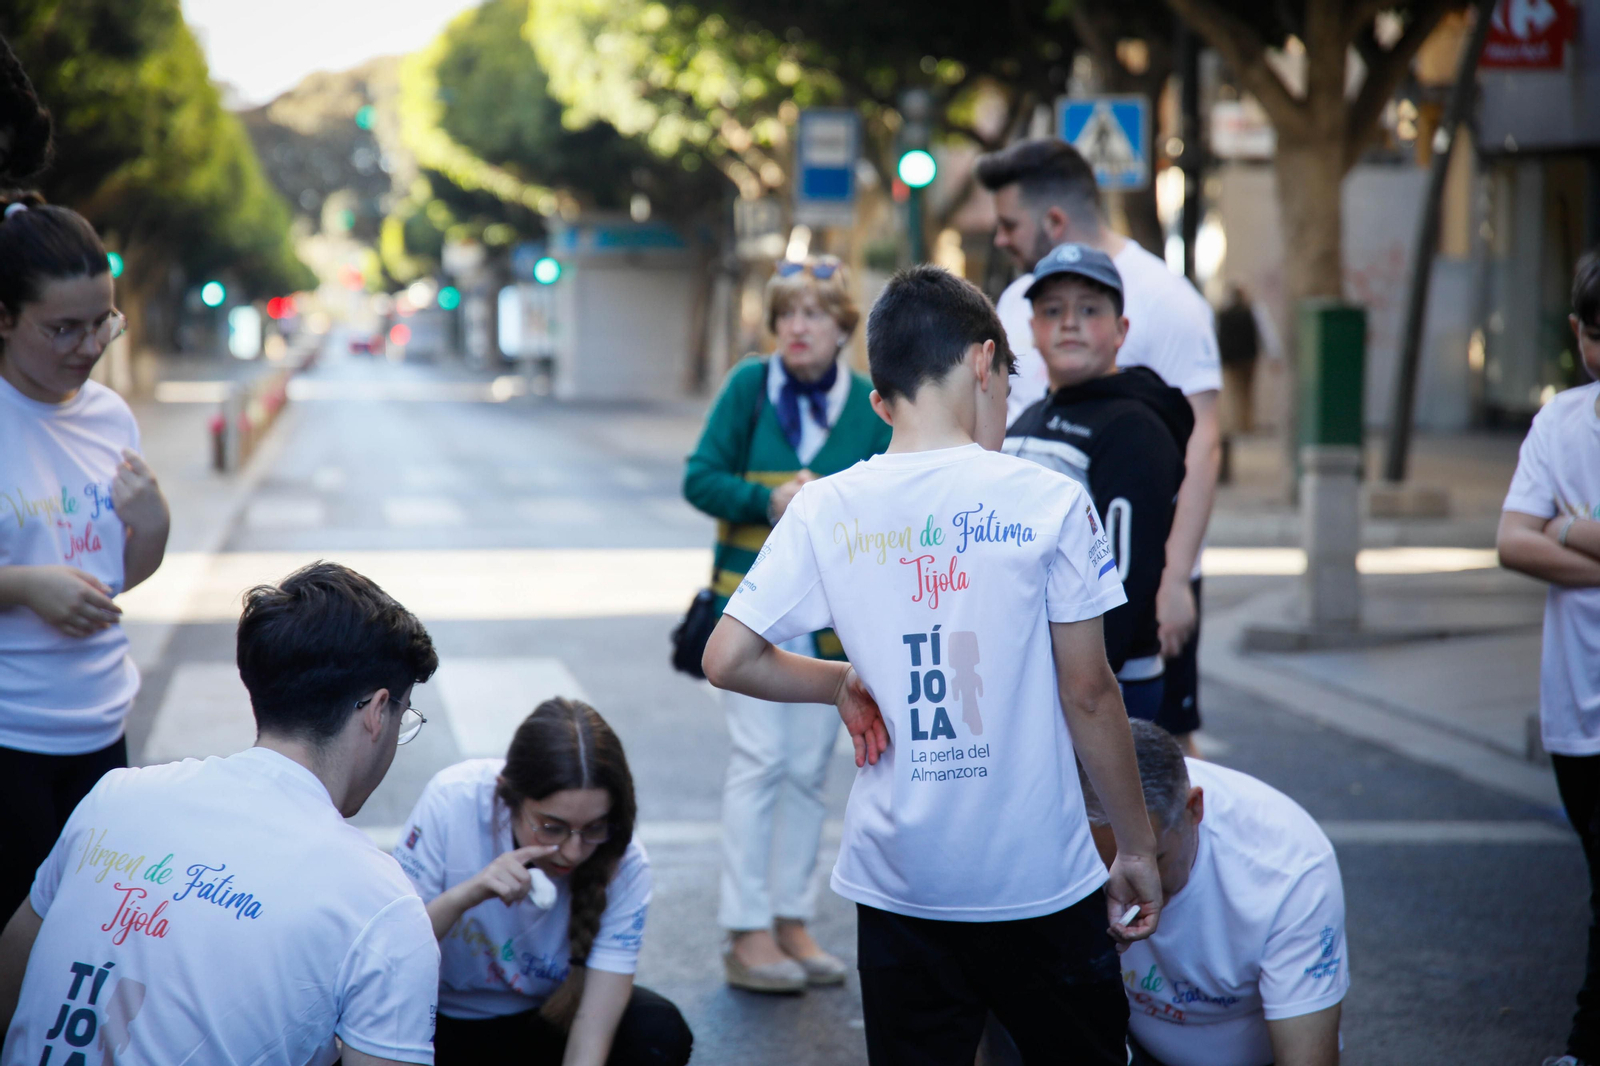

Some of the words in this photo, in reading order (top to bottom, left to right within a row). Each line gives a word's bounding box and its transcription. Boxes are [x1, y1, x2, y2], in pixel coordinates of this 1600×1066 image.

[833, 518, 913, 565] Virgen
[920, 514, 945, 547] de
[952, 503, 1037, 553] Fátima
[899, 554, 970, 610] Tíjola
[902, 624, 942, 667] TÍ
[907, 669, 947, 705] JO
[910, 706, 957, 741] LA
[911, 749, 927, 763] La
[930, 746, 964, 765] perla
[968, 743, 990, 759] del
[911, 766, 988, 782] Almanzora
[75, 827, 146, 883] Virgen
[143, 853, 174, 885] de
[172, 863, 263, 920] Fátima
[101, 882, 171, 946] Tíjola
[66, 961, 116, 1006] TÍ
[1141, 964, 1164, 993] de
[45, 1003, 98, 1048] JO
